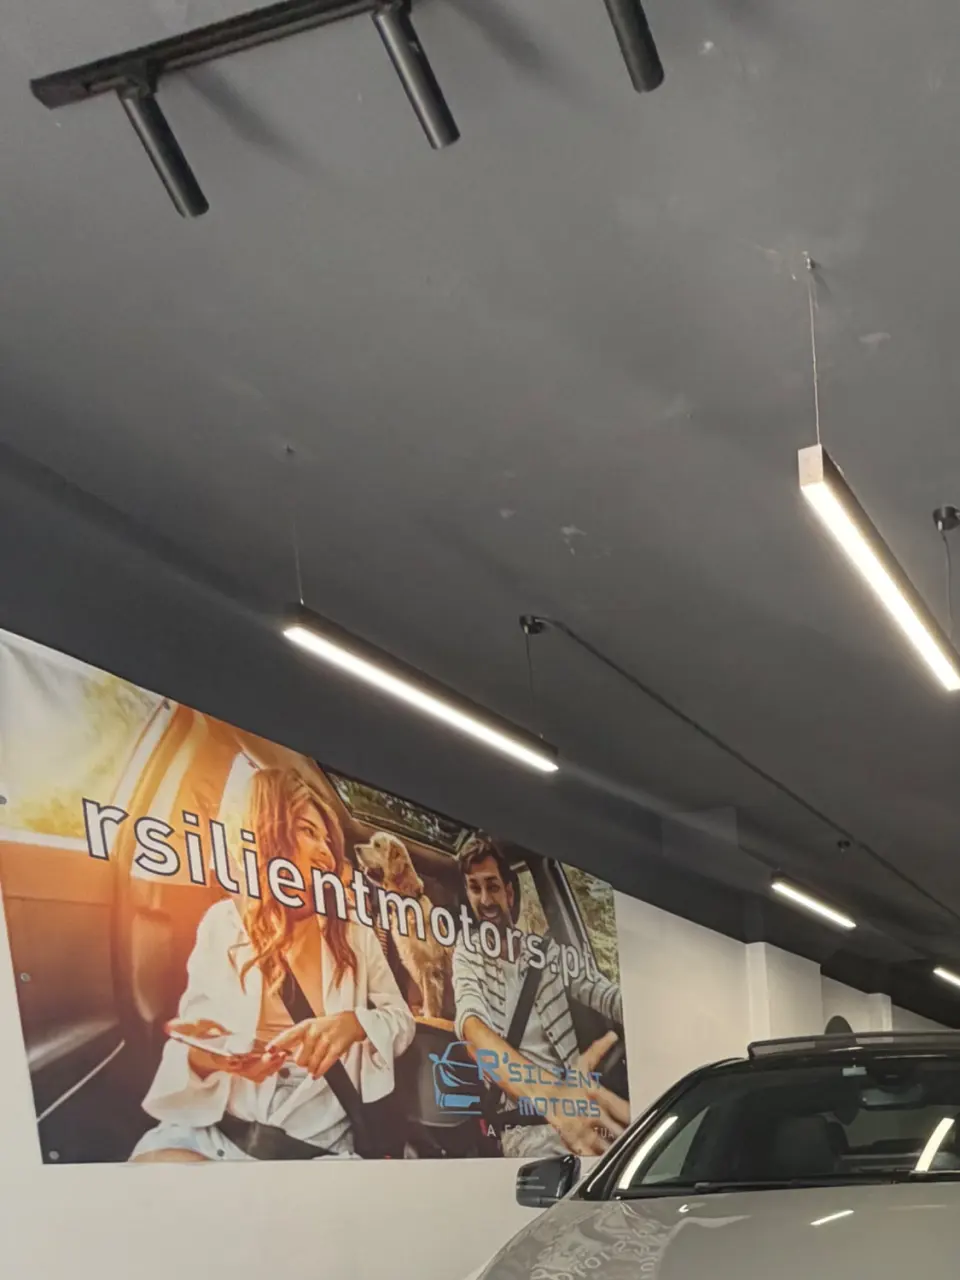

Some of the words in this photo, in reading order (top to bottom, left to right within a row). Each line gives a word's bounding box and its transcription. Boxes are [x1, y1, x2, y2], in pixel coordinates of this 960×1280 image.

[82, 797, 601, 987] rsilientmotors.pt
[519, 1096, 601, 1118] MOTORS
[486, 1123, 497, 1138] A
